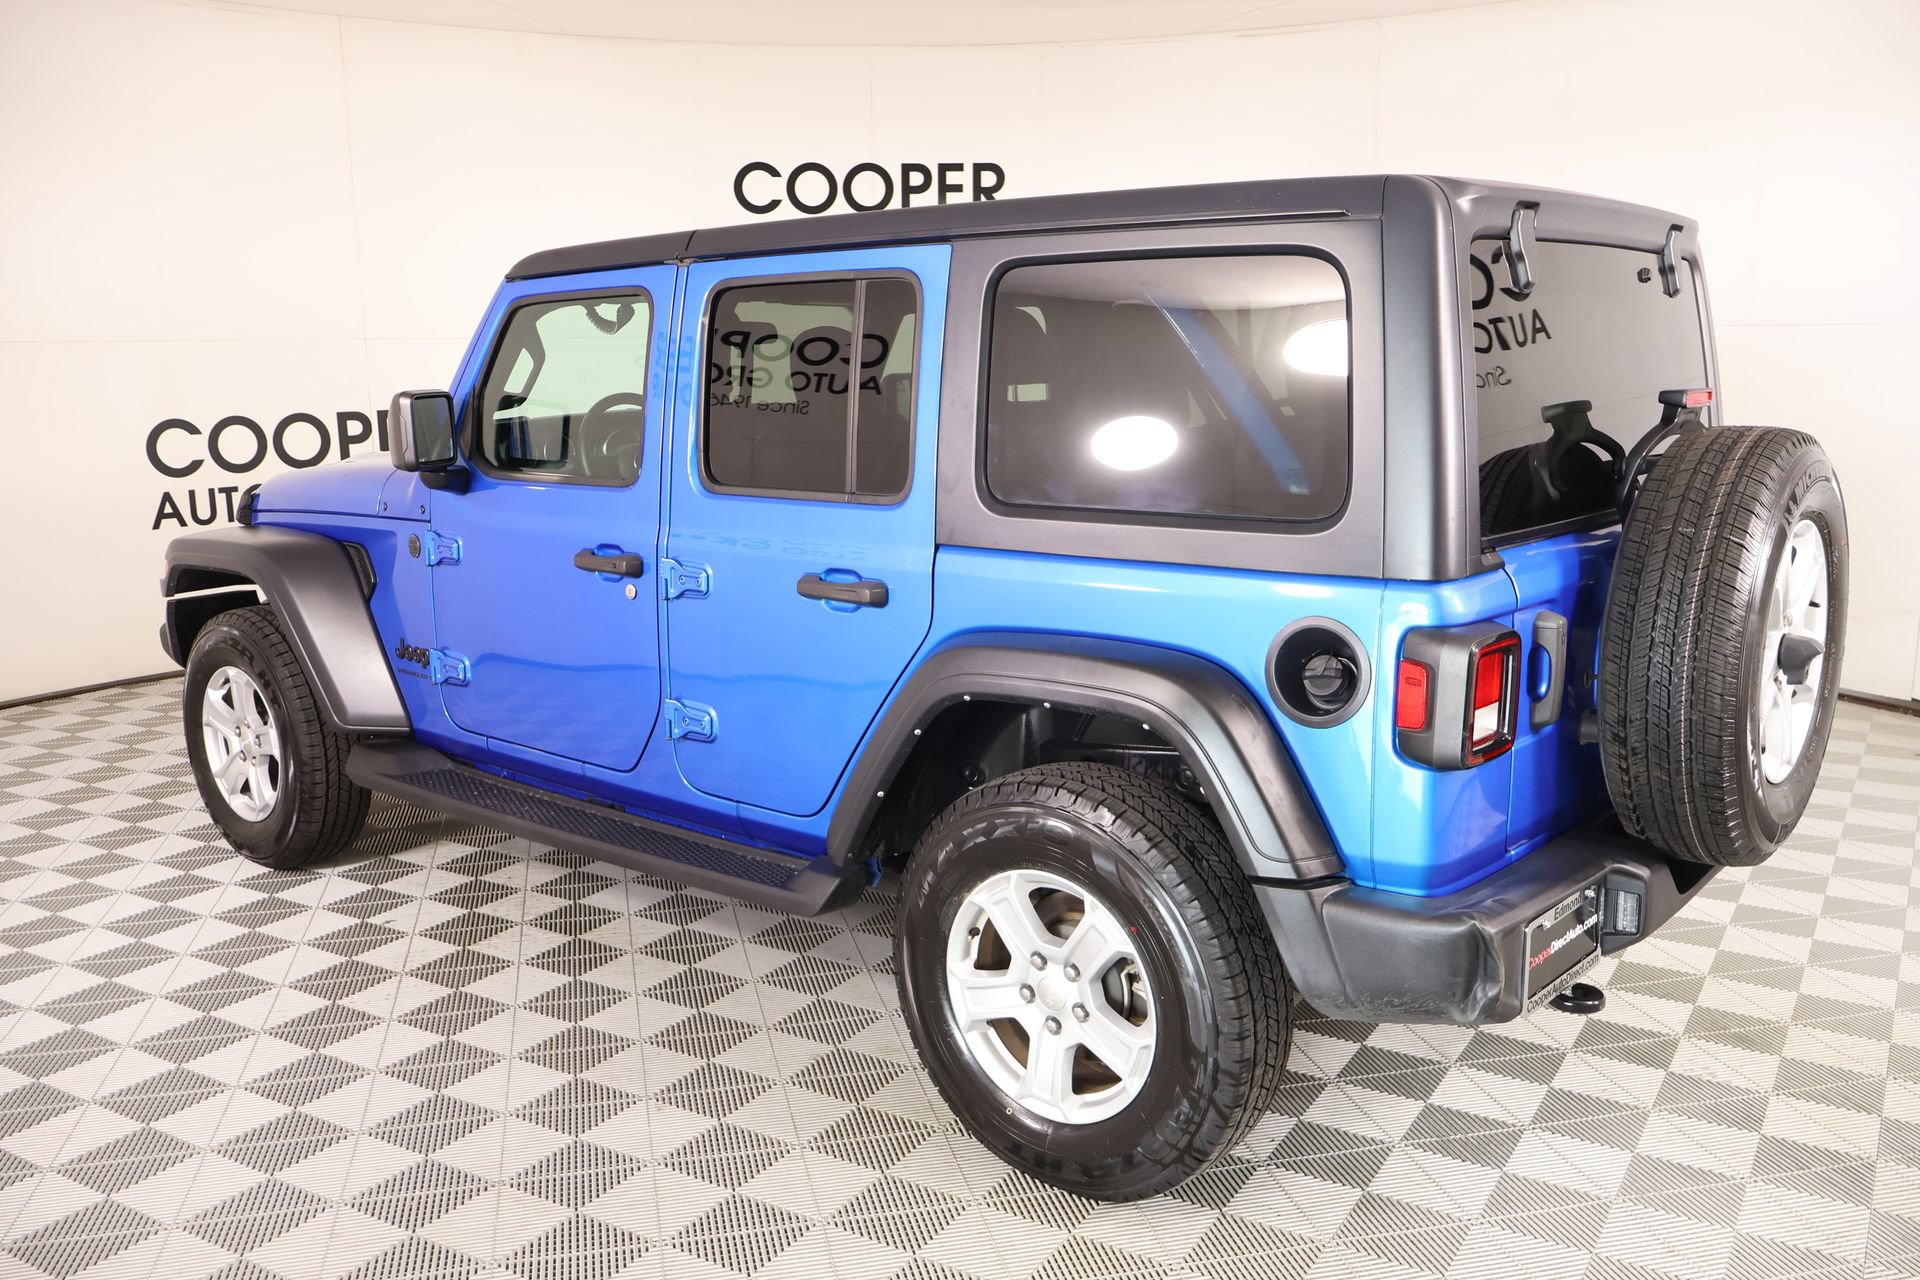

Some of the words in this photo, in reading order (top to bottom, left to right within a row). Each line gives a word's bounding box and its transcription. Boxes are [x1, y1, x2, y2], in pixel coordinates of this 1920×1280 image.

[733, 161, 1006, 215] COOPER
[152, 483, 263, 530] AUT
[395, 637, 430, 670] Jeep
[1554, 894, 1582, 921] Edmond
